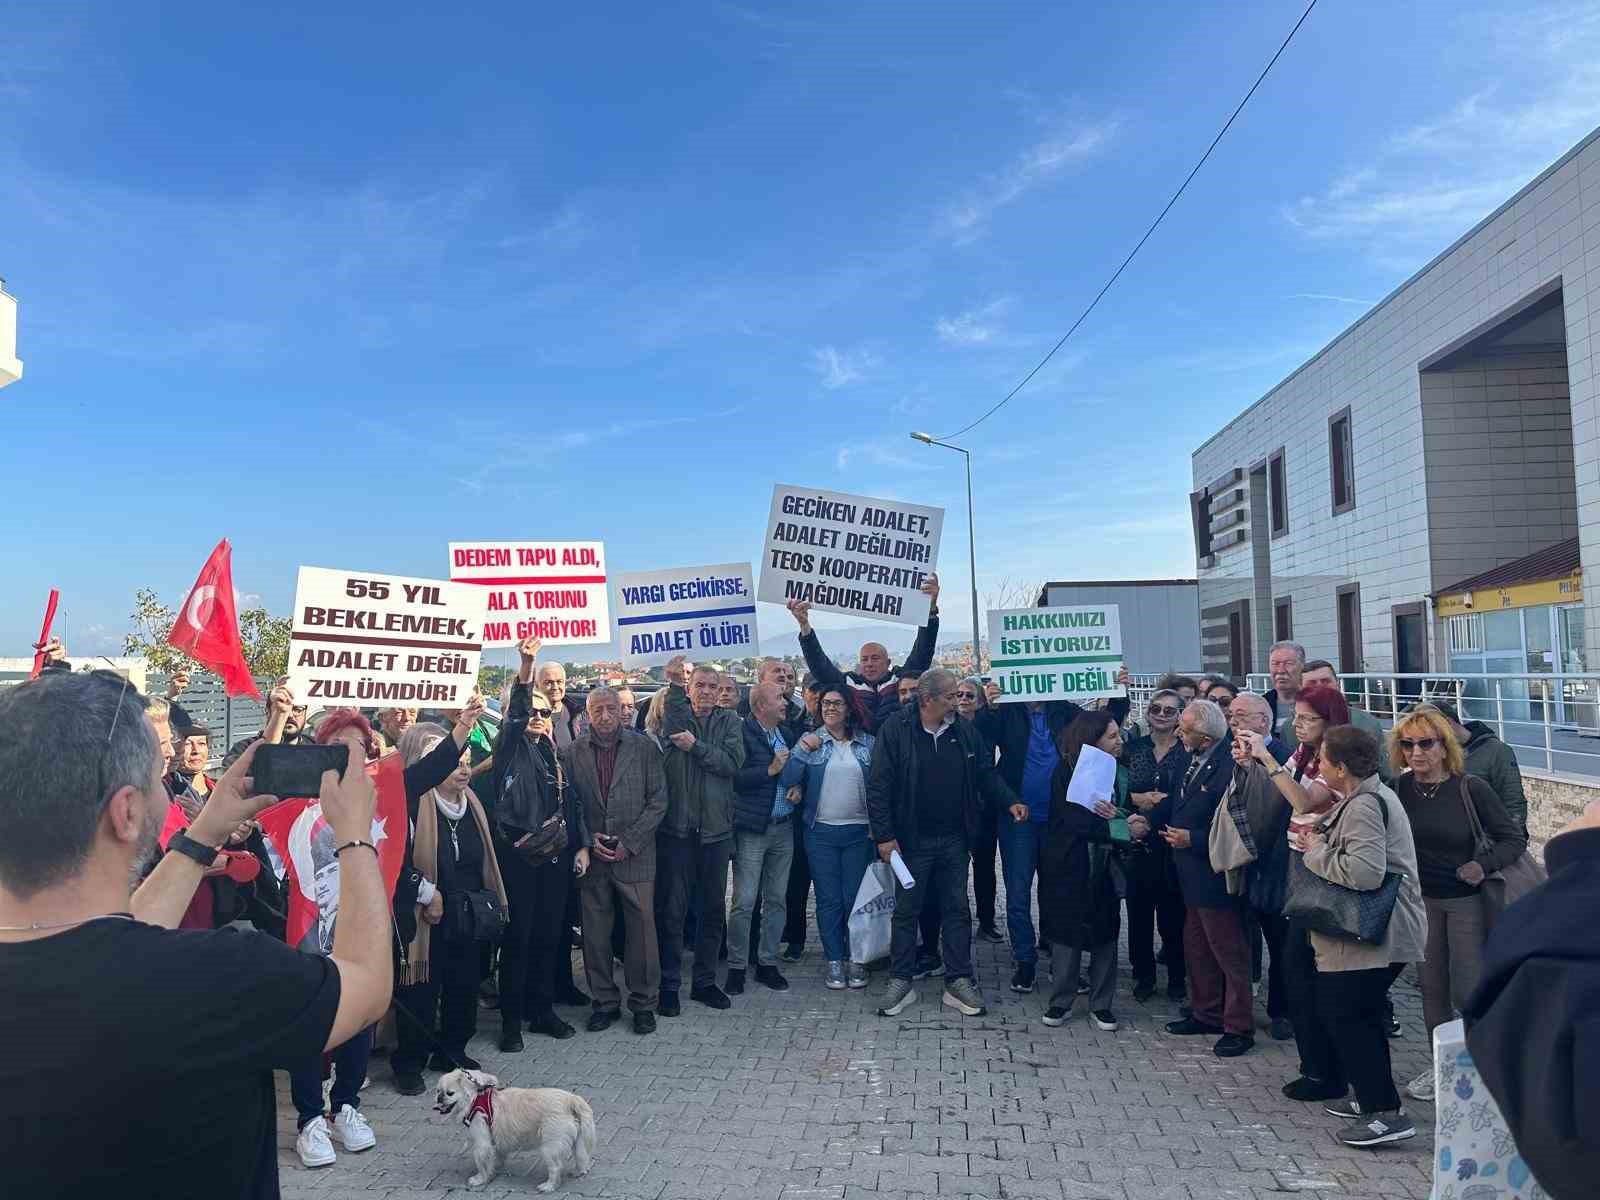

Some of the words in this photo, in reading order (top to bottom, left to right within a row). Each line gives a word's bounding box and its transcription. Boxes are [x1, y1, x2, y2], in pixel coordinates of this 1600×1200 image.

[782, 496, 856, 523] GECİKEN
[860, 507, 930, 538] ADALET,
[773, 522, 841, 549] ADALET
[845, 532, 930, 564] DEĞİLDİR!
[454, 549, 511, 567] DEDEM
[517, 548, 556, 567] TAPU
[562, 548, 600, 569] ALDI,
[771, 549, 814, 573] TEOS
[346, 579, 391, 600] 55
[402, 584, 447, 606] YIL
[488, 592, 519, 611] ALA
[523, 590, 587, 609] TORUNU
[622, 584, 666, 606] YARGI
[669, 576, 748, 601] GECİKİRSE,
[784, 579, 903, 617] MAĞDURLARI
[303, 606, 475, 640] BEKLEMEK,
[483, 622, 511, 641] AVA
[517, 619, 597, 641] GÖRÜYOR!
[1003, 611, 1106, 631] HAKKIMIZI
[631, 630, 693, 655] ADALET
[700, 623, 749, 649] ÖLÜR!
[1000, 635, 1110, 655] İSTİYORUZ!
[297, 648, 399, 672] ADALET
[407, 652, 472, 675] DEĞİL
[307, 678, 457, 702] ZULÜMDÜR!
[999, 671, 1057, 696] LÜTUF
